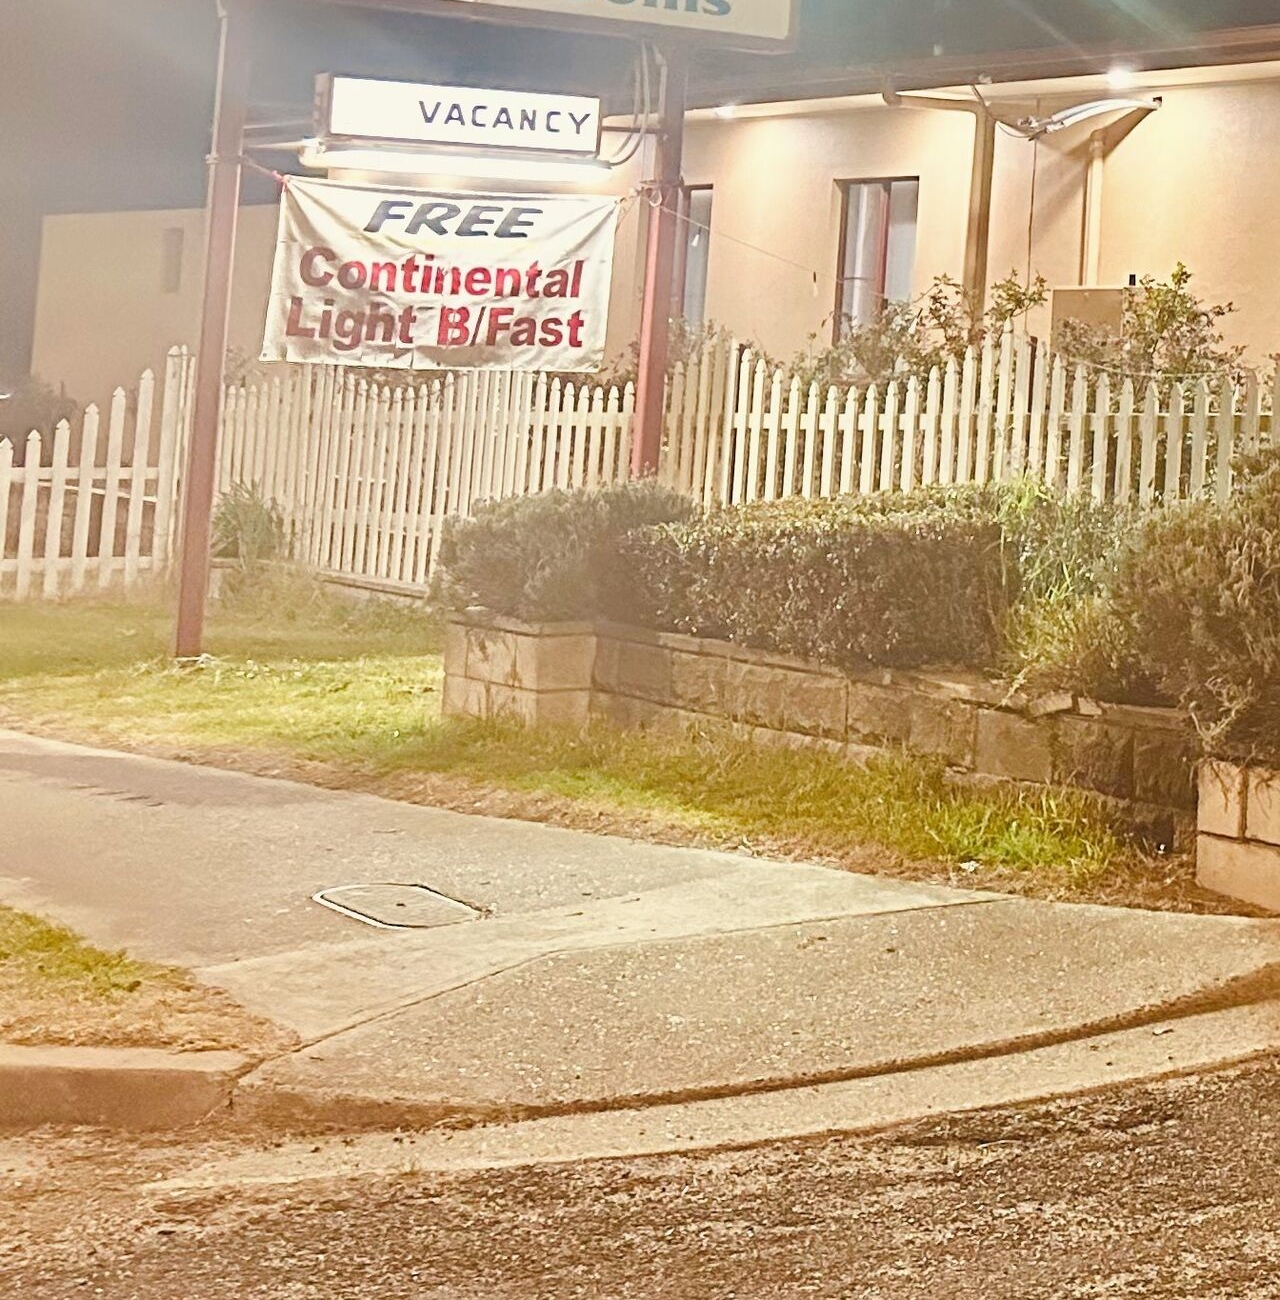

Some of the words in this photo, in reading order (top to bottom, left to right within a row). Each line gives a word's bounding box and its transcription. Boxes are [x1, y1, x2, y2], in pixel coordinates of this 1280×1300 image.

[418, 100, 591, 135] VACANCY
[363, 200, 544, 239] FREE
[300, 246, 585, 299] Continental
[285, 297, 418, 351] Light
[437, 305, 585, 349] B/Fast
